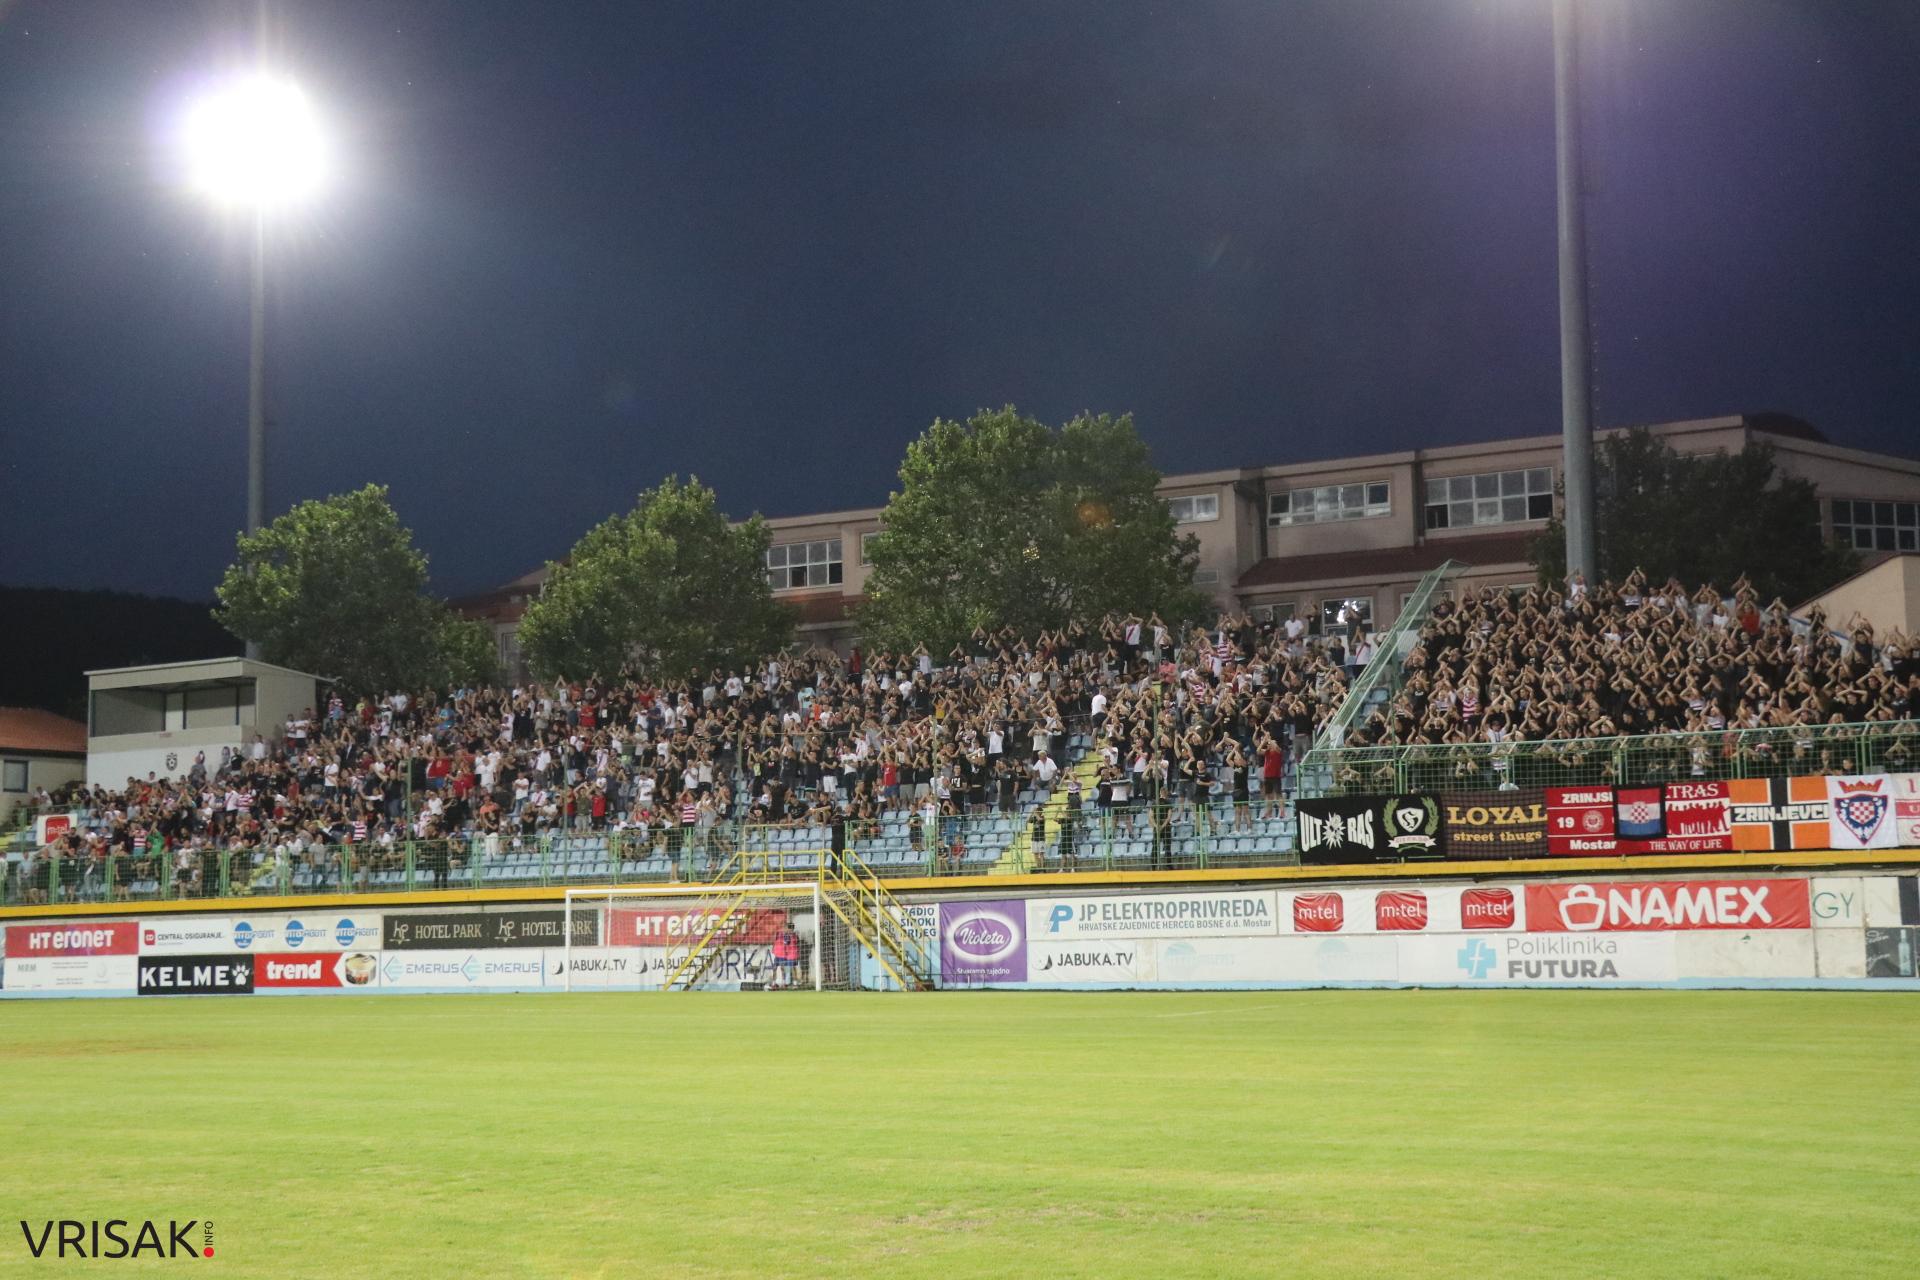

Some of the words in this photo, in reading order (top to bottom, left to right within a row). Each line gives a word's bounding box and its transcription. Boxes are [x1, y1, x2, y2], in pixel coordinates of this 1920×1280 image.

[1665, 783, 1719, 799] TRAS
[1447, 804, 1548, 826] LOYAL
[1556, 816, 1575, 829] 19
[1453, 831, 1495, 842] street
[1500, 830, 1542, 843] thugs
[1649, 841, 1667, 851] THE
[1668, 840, 1689, 850] WAY
[1690, 839, 1701, 849] OF
[1703, 838, 1722, 849] LIFE
[1569, 839, 1617, 851] Mostar
[1079, 903, 1097, 922] JP
[1102, 898, 1268, 921] ELEKTROPRIVREDA
[1299, 905, 1338, 920] m:tel
[1381, 902, 1422, 918] m:tel
[1466, 899, 1508, 916] m:tel
[1609, 885, 1772, 925] NAMEX
[415, 924, 451, 939] HOTEL
[453, 923, 483, 938] PARK
[521, 921, 559, 937] HOTEL
[636, 915, 665, 937] HT
[1078, 921, 1118, 931] HRVATSKE
[1119, 920, 1161, 931] ZAJEDNICE
[1162, 920, 1195, 930] HERCEG
[1196, 919, 1224, 929] BOSNE
[1225, 918, 1241, 928] d.d.
[1243, 918, 1272, 928] Mostar
[29, 931, 51, 950] HT
[157, 933, 183, 941] CENTRAL
[960, 928, 1005, 946] Violeta
[1507, 936, 1618, 955] Poliklinika
[485, 962, 541, 973] EMERUS
[1057, 952, 1134, 967] JABUKA.TV
[141, 965, 230, 988] KELME
[266, 960, 322, 980] trend
[406, 963, 460, 974] EMERUS
[1508, 959, 1619, 979] FUTURA
